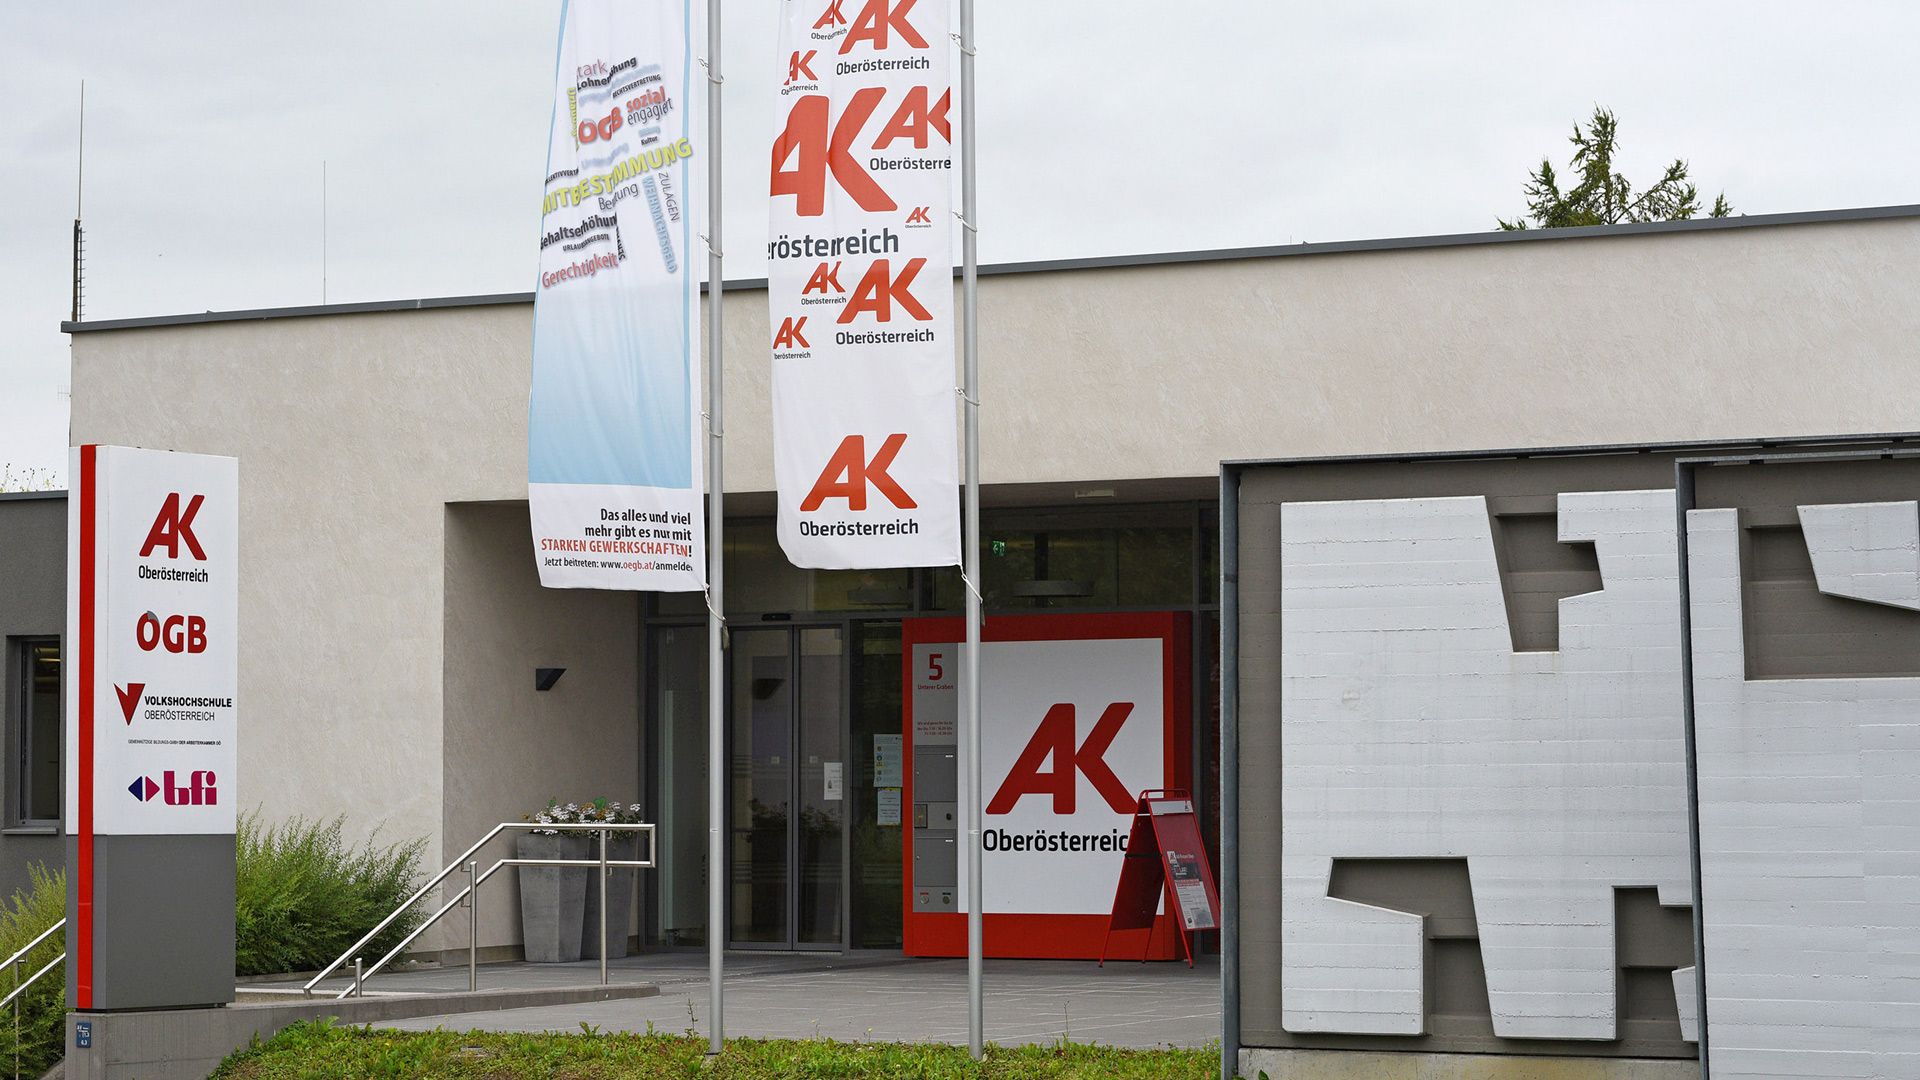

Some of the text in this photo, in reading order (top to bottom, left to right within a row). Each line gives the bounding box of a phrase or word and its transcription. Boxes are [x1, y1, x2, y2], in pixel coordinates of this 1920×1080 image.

[838, 0, 930, 54] AK
[836, 56, 930, 76] Oberösterreich
[627, 85, 666, 113] sozial
[627, 98, 673, 126] engagiert
[871, 86, 951, 150] AK
[770, 87, 898, 216] AK
[658, 172, 680, 222] ZULAGEN
[906, 206, 932, 223] AK
[541, 252, 619, 289] Gerechtigkeit
[802, 261, 847, 295] AK
[801, 296, 847, 306] Oberösterreich
[836, 258, 934, 324] AK
[773, 316, 811, 350] AK
[836, 329, 934, 345] Oberösterreich
[800, 433, 918, 511] AK
[138, 492, 208, 561] AK
[600, 508, 691, 525] Das alles und viel
[800, 518, 919, 536] Oberösterreich
[585, 525, 692, 541] mehr gibt es nur mit
[541, 538, 692, 558] STARKEN GEWERKSCHAFTEN!
[138, 565, 209, 583] Oberösterreich
[544, 557, 562, 567] Jetzt
[563, 557, 599, 569] beitreten:
[929, 653, 943, 681] 5
[144, 708, 215, 721] OBERÖSTERREICH
[145, 695, 232, 708] VOLKSHOCHSCHULE
[985, 702, 1138, 815] AK
[163, 770, 218, 806] bfi
[982, 828, 1132, 852] Oberösterreic
